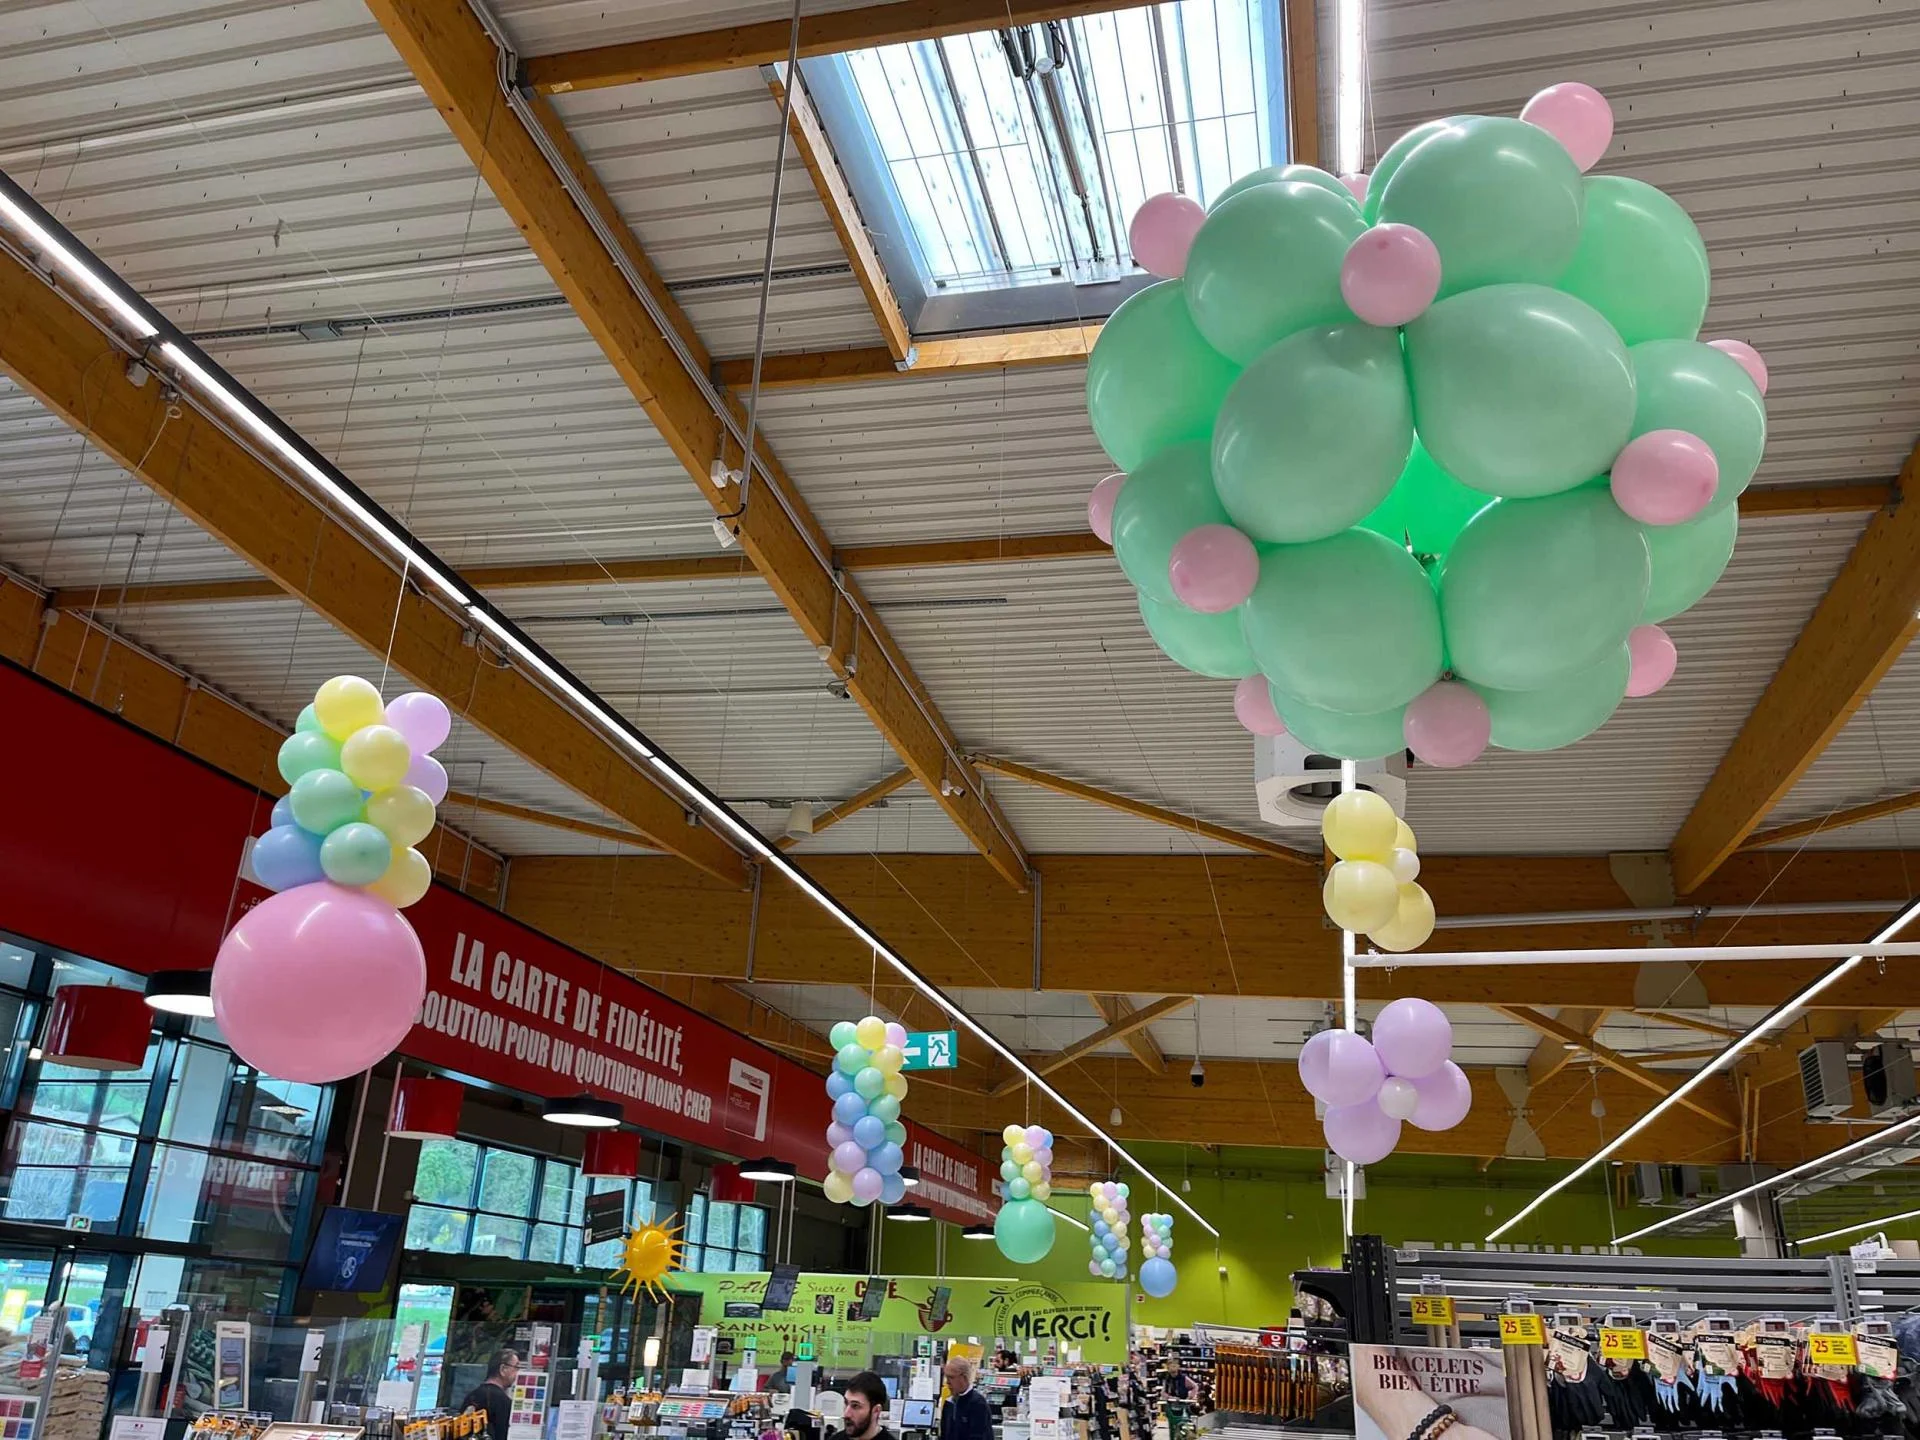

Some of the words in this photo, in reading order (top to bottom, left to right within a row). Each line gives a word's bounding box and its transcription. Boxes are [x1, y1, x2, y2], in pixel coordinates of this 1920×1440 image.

[450, 931, 485, 992] LA
[491, 951, 570, 1025] CARTE
[573, 986, 602, 1039] DE
[605, 1000, 684, 1077] FIDÉLITÉ,
[504, 1019, 551, 1068] POUR
[550, 1037, 575, 1077] UN
[574, 1047, 645, 1101] QUOTIDIEN
[645, 1074, 684, 1115] MOINS
[683, 1087, 713, 1125] CHER
[855, 1279, 898, 1298] CÉ
[715, 1321, 826, 1334] SANDWICH
[160, 1344, 166, 1359] 1
[314, 1346, 322, 1360] 2
[1373, 1355, 1484, 1375] BRACELETS
[1379, 1374, 1481, 1394] BIEN-ÊTRE
